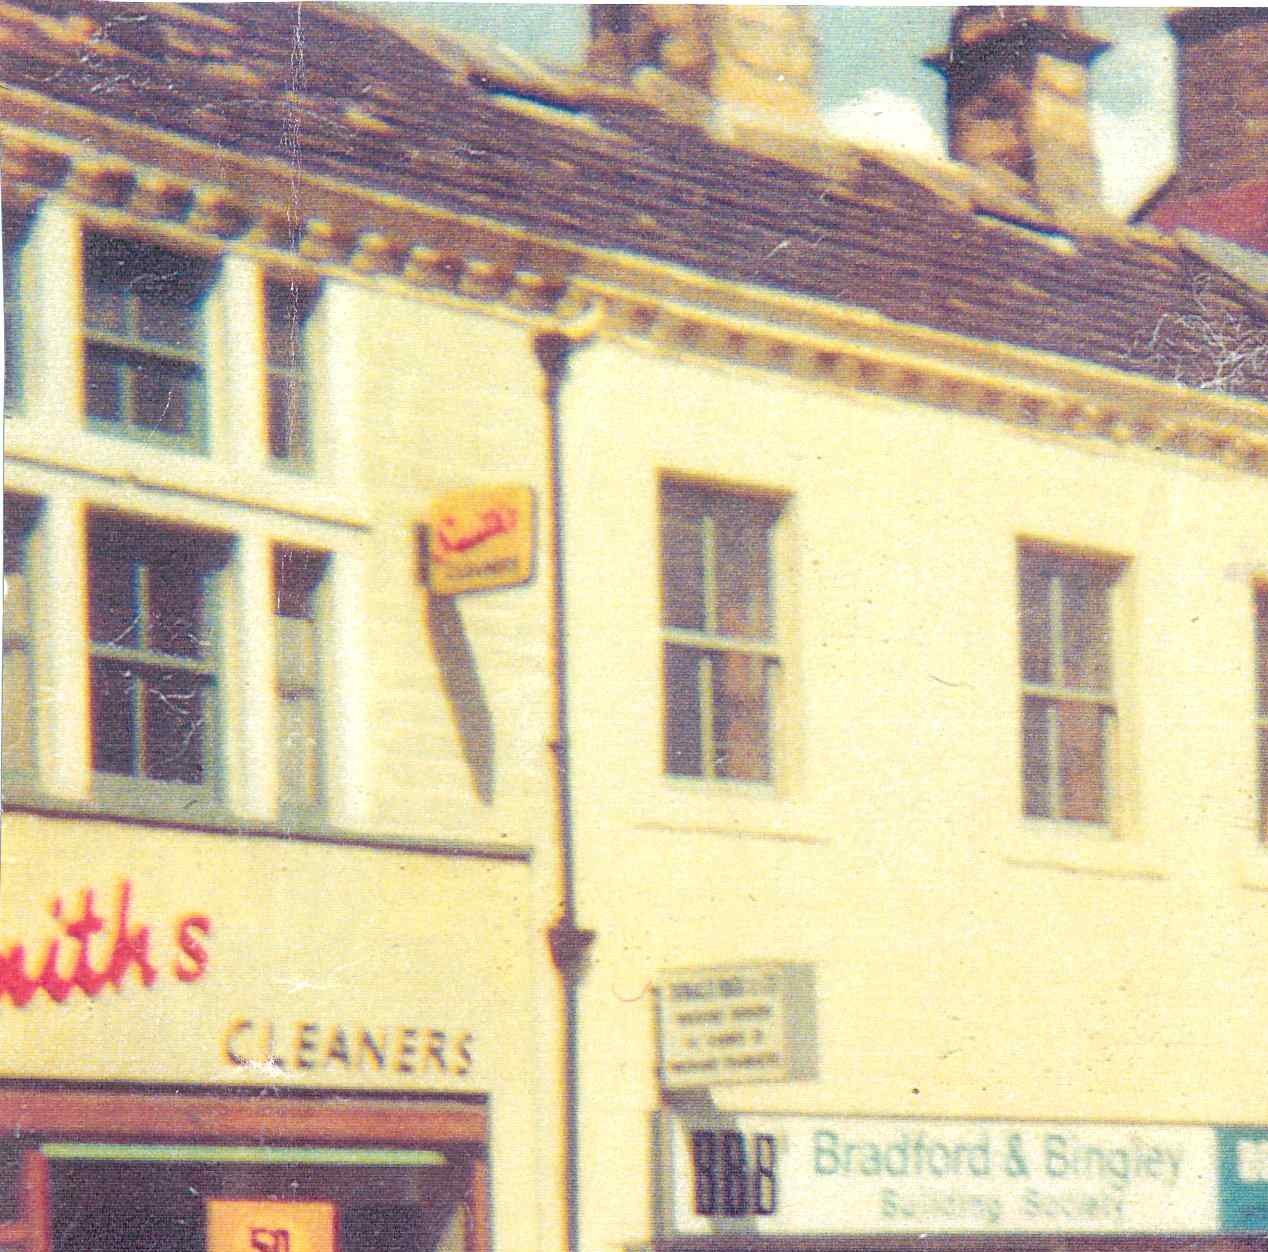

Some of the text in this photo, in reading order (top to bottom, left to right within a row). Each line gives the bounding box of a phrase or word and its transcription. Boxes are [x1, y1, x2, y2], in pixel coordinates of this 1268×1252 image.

[223, 1017, 475, 1076] CLEANERS
[813, 1130, 992, 1178] Bradford
[1006, 1132, 1030, 1178] &
[1044, 1134, 1184, 1188] Bingley
